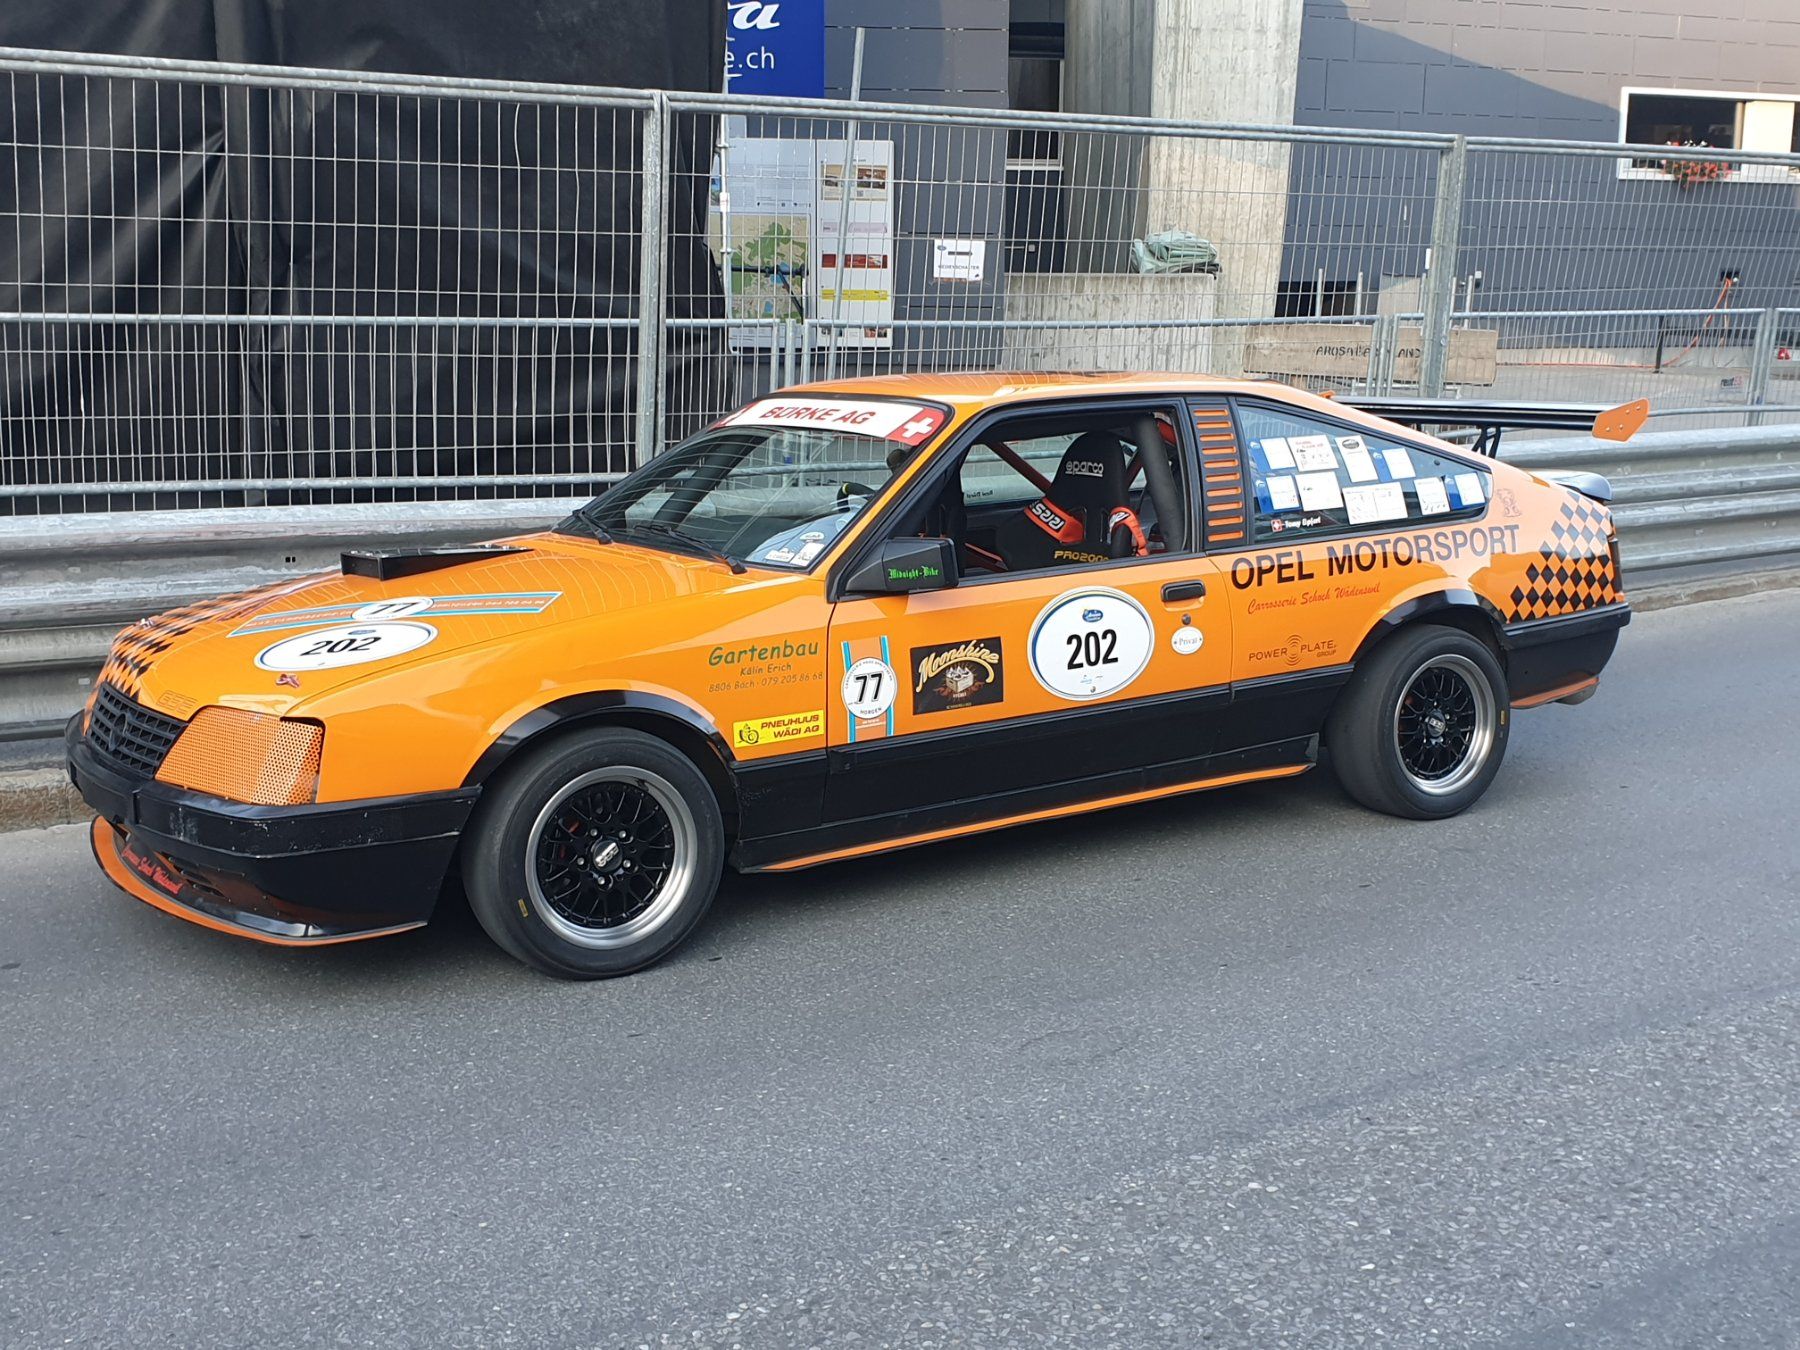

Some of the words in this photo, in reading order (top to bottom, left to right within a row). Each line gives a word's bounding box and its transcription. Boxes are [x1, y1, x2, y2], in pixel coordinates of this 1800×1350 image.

[833, 411, 876, 425] AG
[1231, 550, 1315, 589] OPEL
[1326, 524, 1520, 577] MOTORSPORT
[1247, 598, 1297, 615] Carrosserie
[1300, 588, 1331, 606] Schoch
[300, 636, 382, 657] 202
[708, 640, 819, 667] Gartenbau
[1066, 628, 1119, 670] 202
[1248, 647, 1288, 662] POWER
[1316, 649, 1337, 658] GROUP
[767, 663, 792, 674] Erich
[916, 640, 1000, 693] Moonshine
[761, 677, 778, 687] 079
[780, 674, 798, 685] 205
[855, 672, 883, 703] 77
[760, 714, 820, 730] PNEUHUUS
[773, 726, 802, 739] WÄDI
[803, 724, 820, 735] AG
